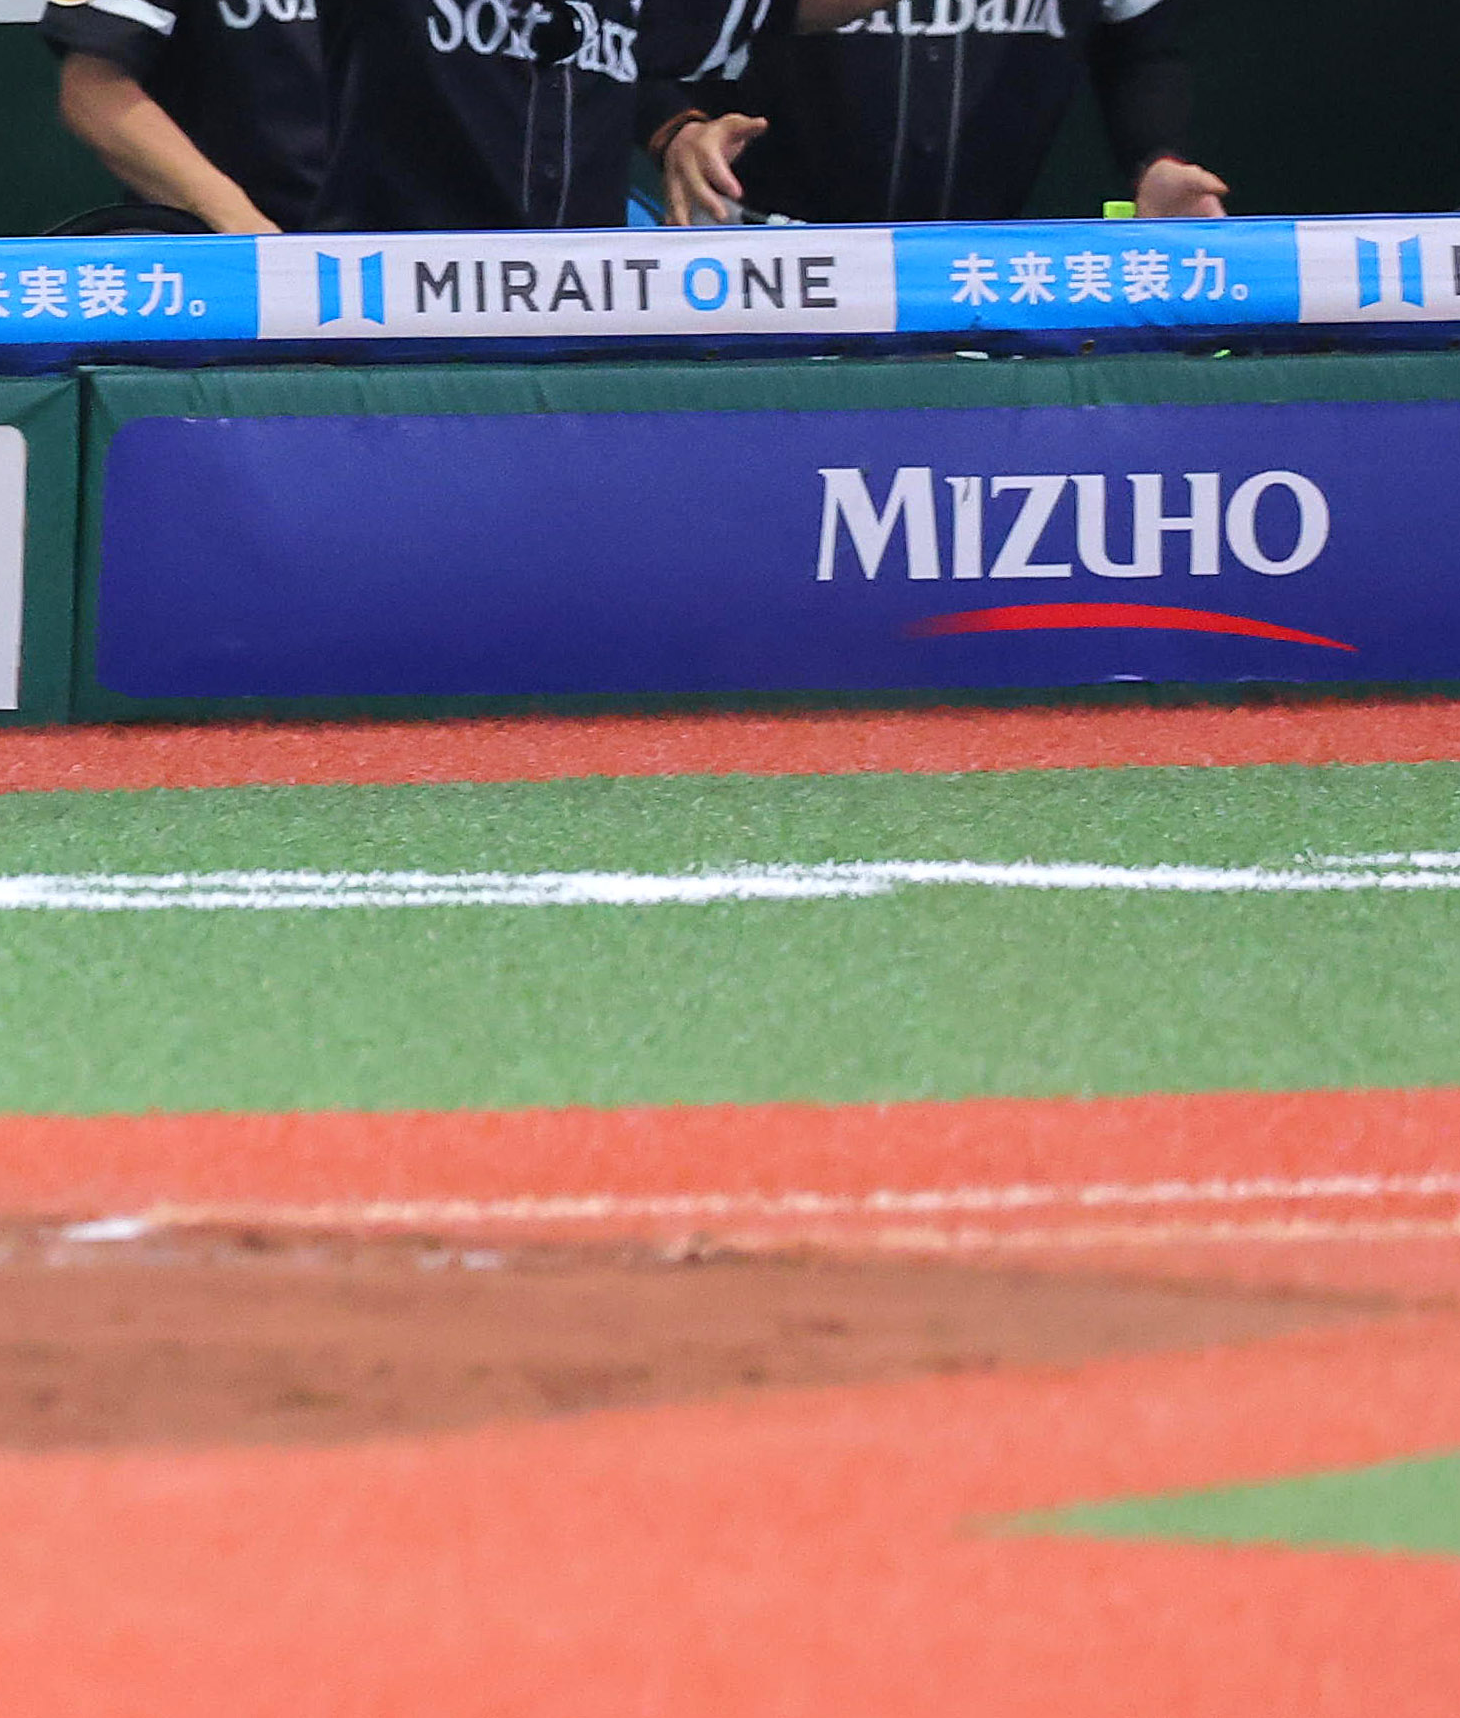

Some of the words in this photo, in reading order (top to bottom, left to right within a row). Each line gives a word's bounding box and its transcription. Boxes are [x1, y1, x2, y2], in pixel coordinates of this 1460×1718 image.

[415, 259, 659, 313] MIRAIT
[682, 256, 837, 311] ONE
[949, 248, 1248, 306] 未来実装力。
[817, 467, 1329, 581] MIZUHO
